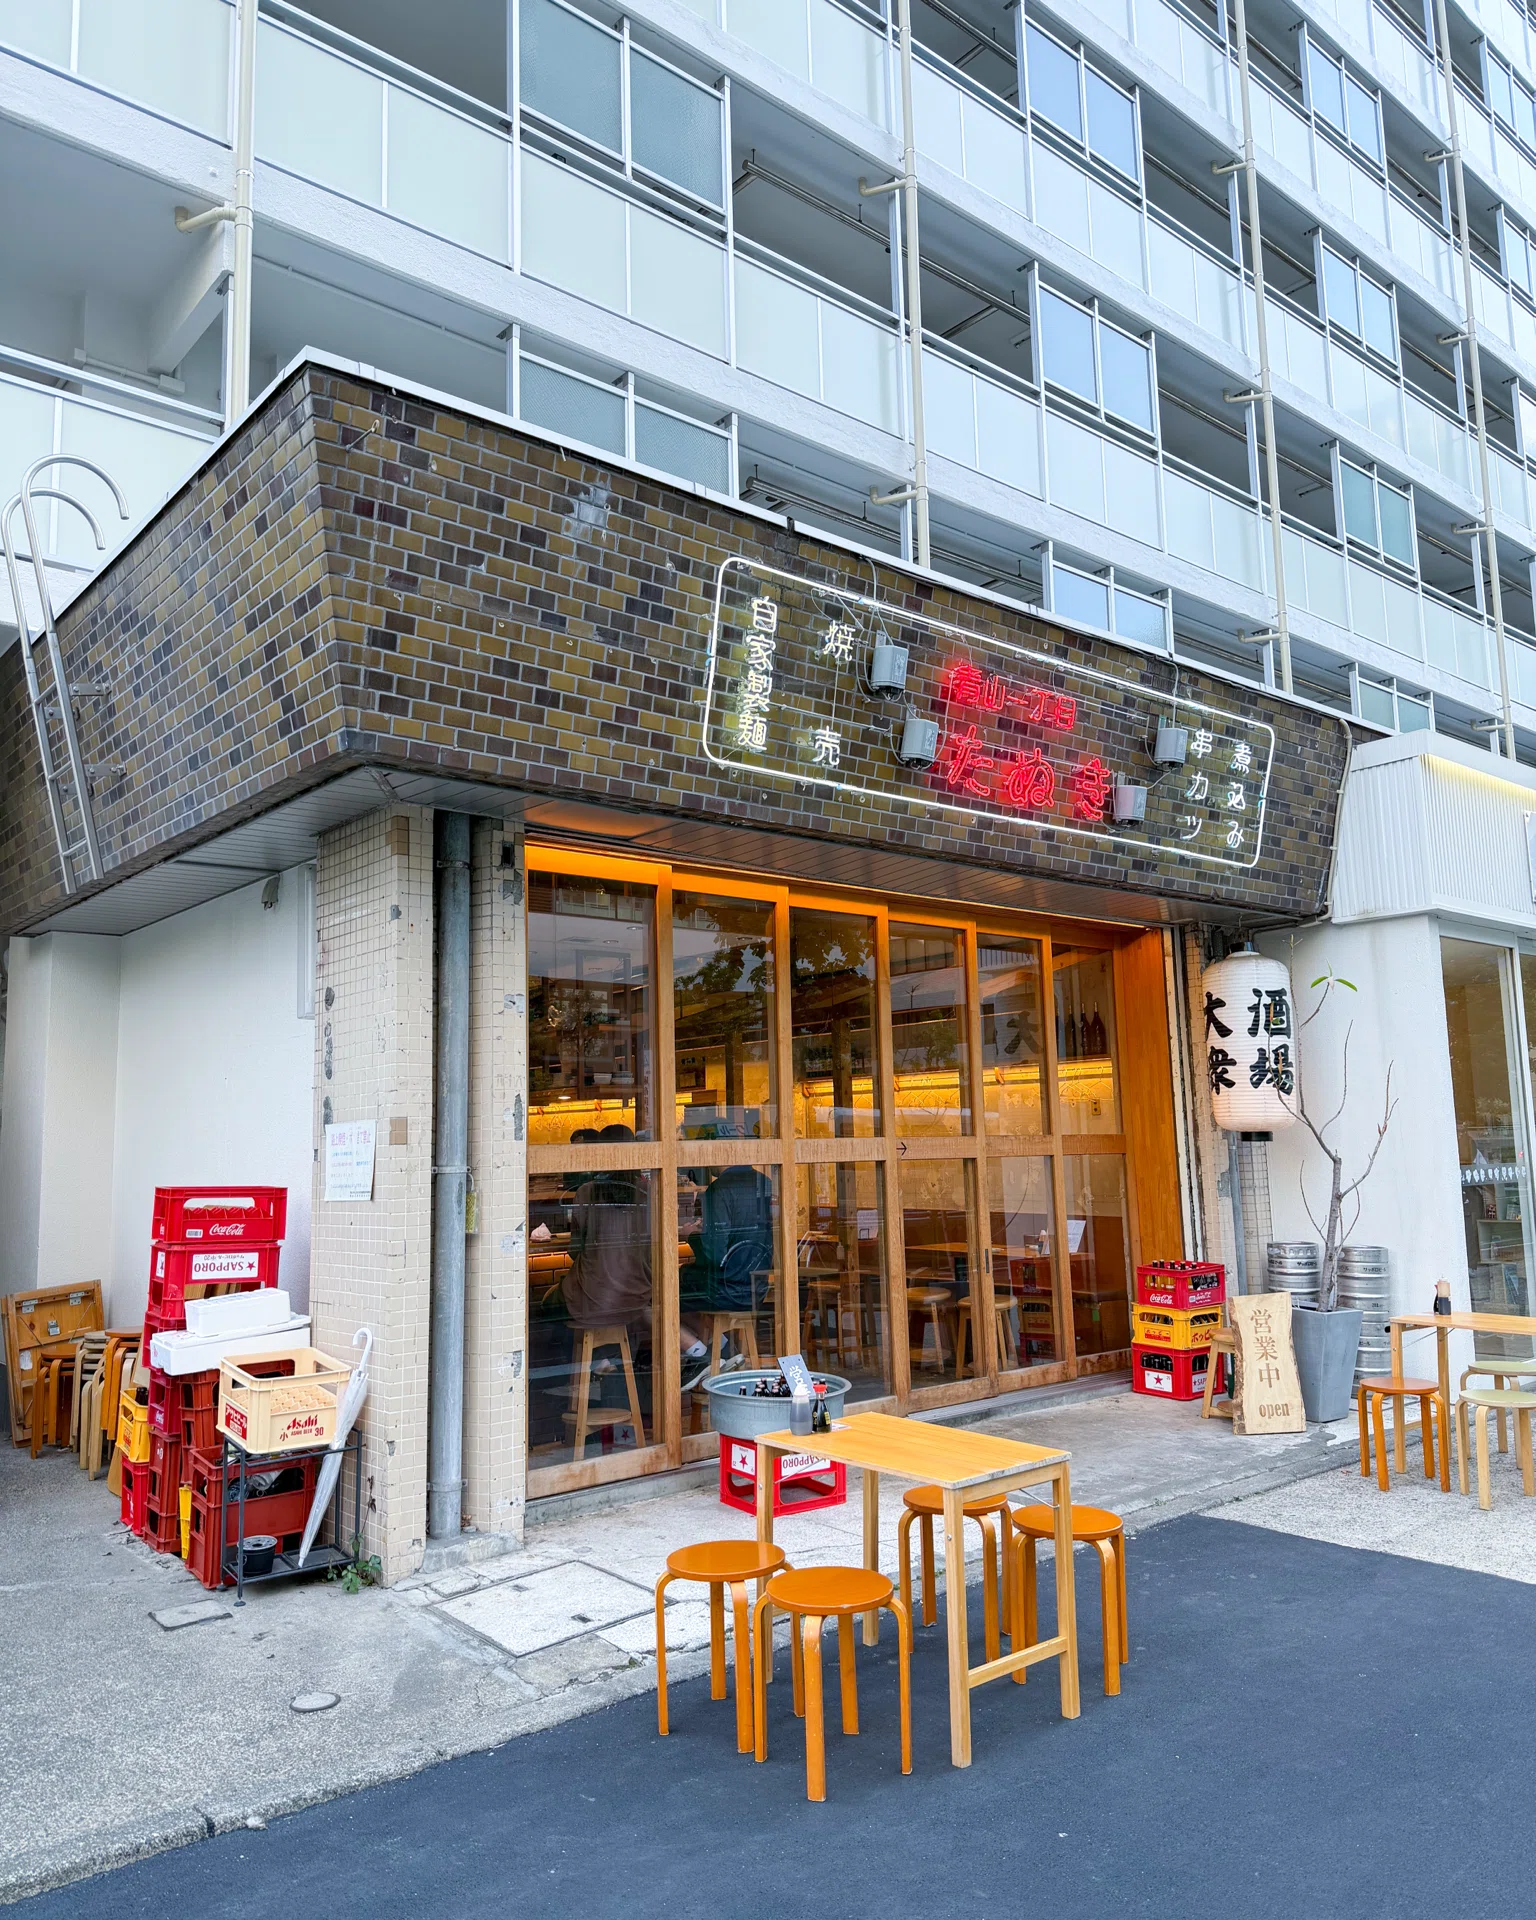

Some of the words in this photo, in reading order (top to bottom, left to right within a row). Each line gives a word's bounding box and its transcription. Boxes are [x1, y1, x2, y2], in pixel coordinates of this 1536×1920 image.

[738, 595, 777, 751] 自家製麺
[953, 664, 1077, 729] 青山一丁目
[947, 724, 1111, 820] たぬき
[1182, 728, 1213, 839] 串カツ
[1247, 987, 1294, 1096] 酒場
[194, 1261, 244, 1273] SAPPORO
[1250, 1309, 1280, 1388] 営業中
[287, 1415, 318, 1431] Asahi
[314, 1426, 324, 1437] 30
[1259, 1403, 1290, 1419] open
